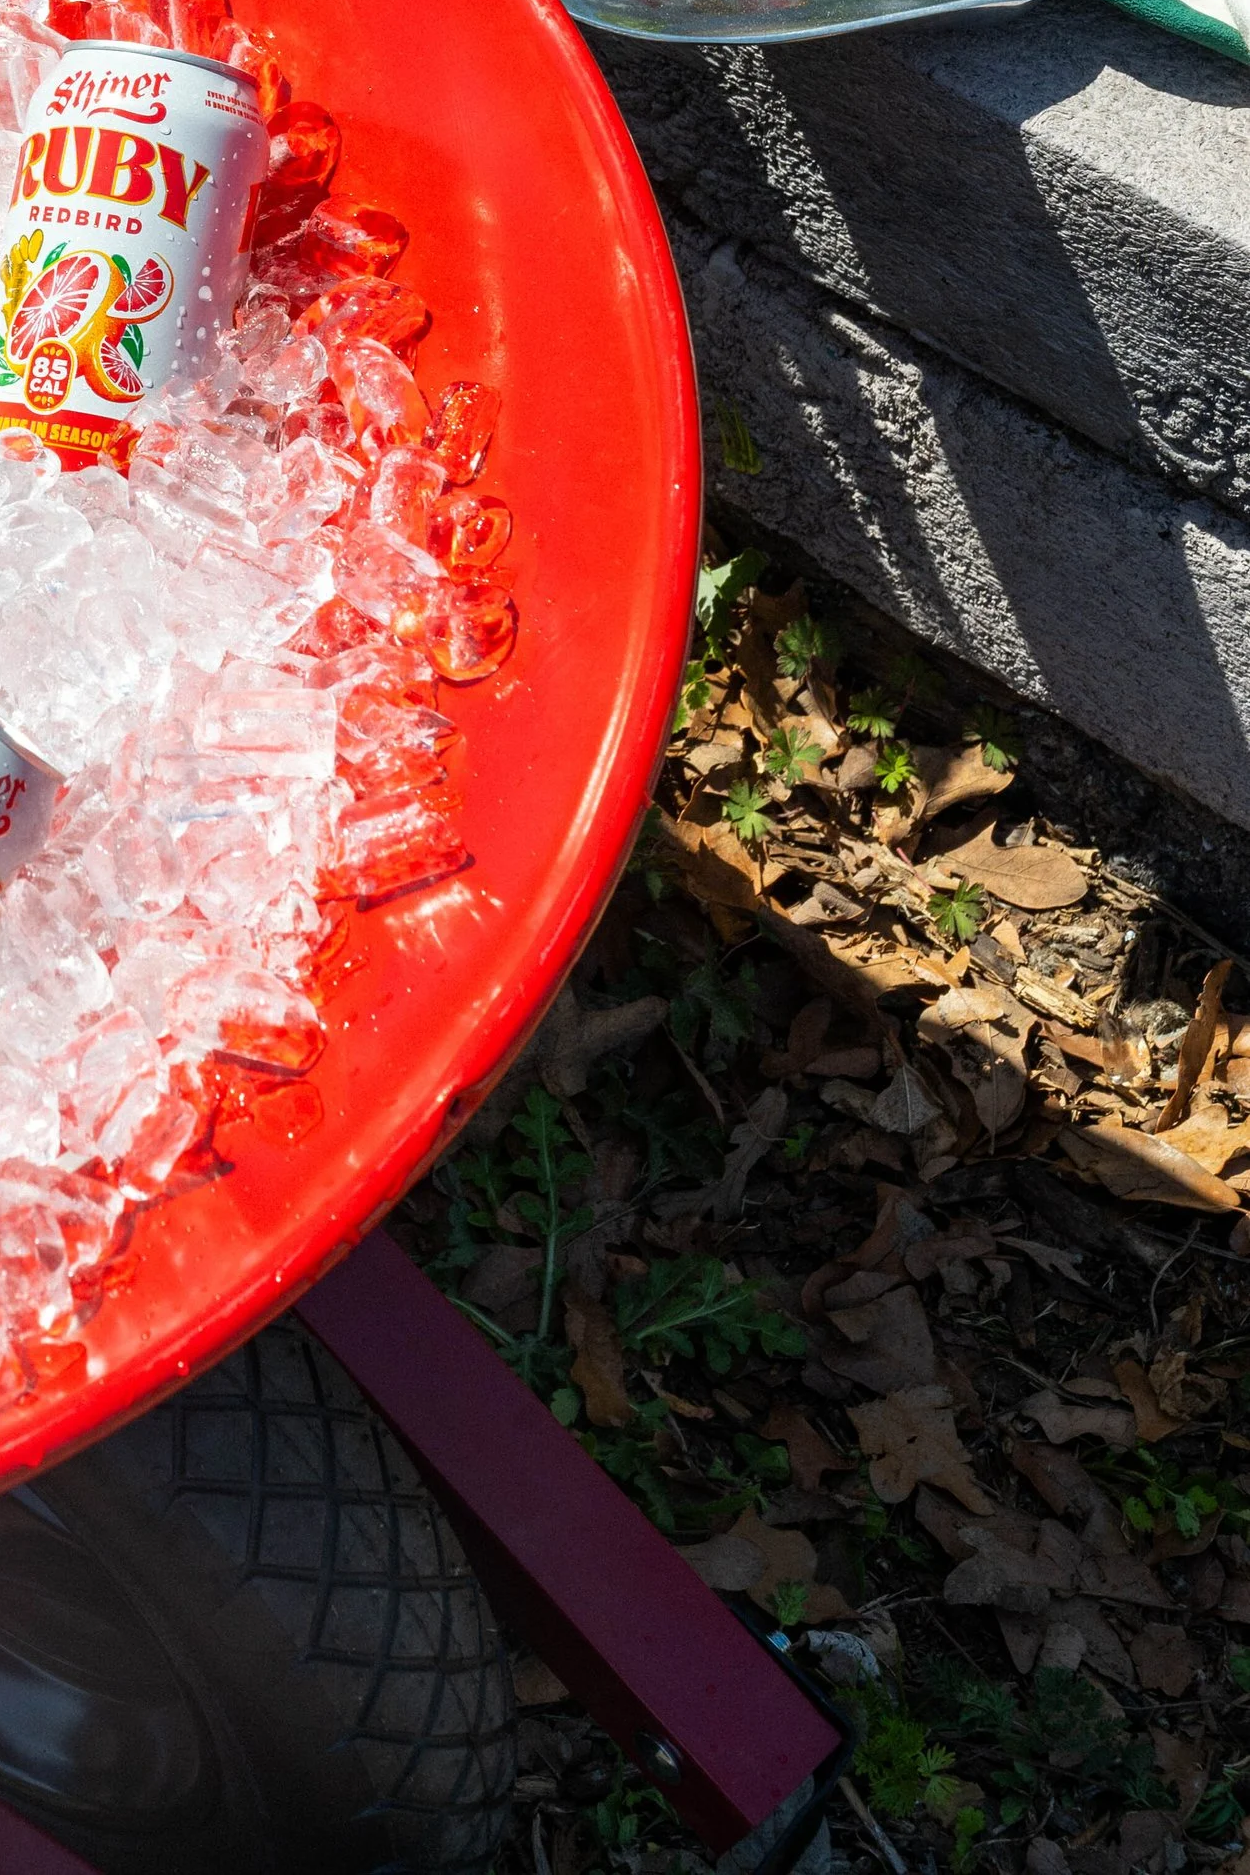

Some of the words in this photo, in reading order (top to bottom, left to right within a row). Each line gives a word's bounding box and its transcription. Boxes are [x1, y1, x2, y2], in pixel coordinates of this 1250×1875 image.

[45, 70, 173, 117] Shiner
[8, 126, 211, 232] RUBY
[29, 205, 144, 235] REDBIRD
[32, 356, 69, 381] 85
[28, 377, 64, 396] CAL
[29, 420, 49, 440] IN
